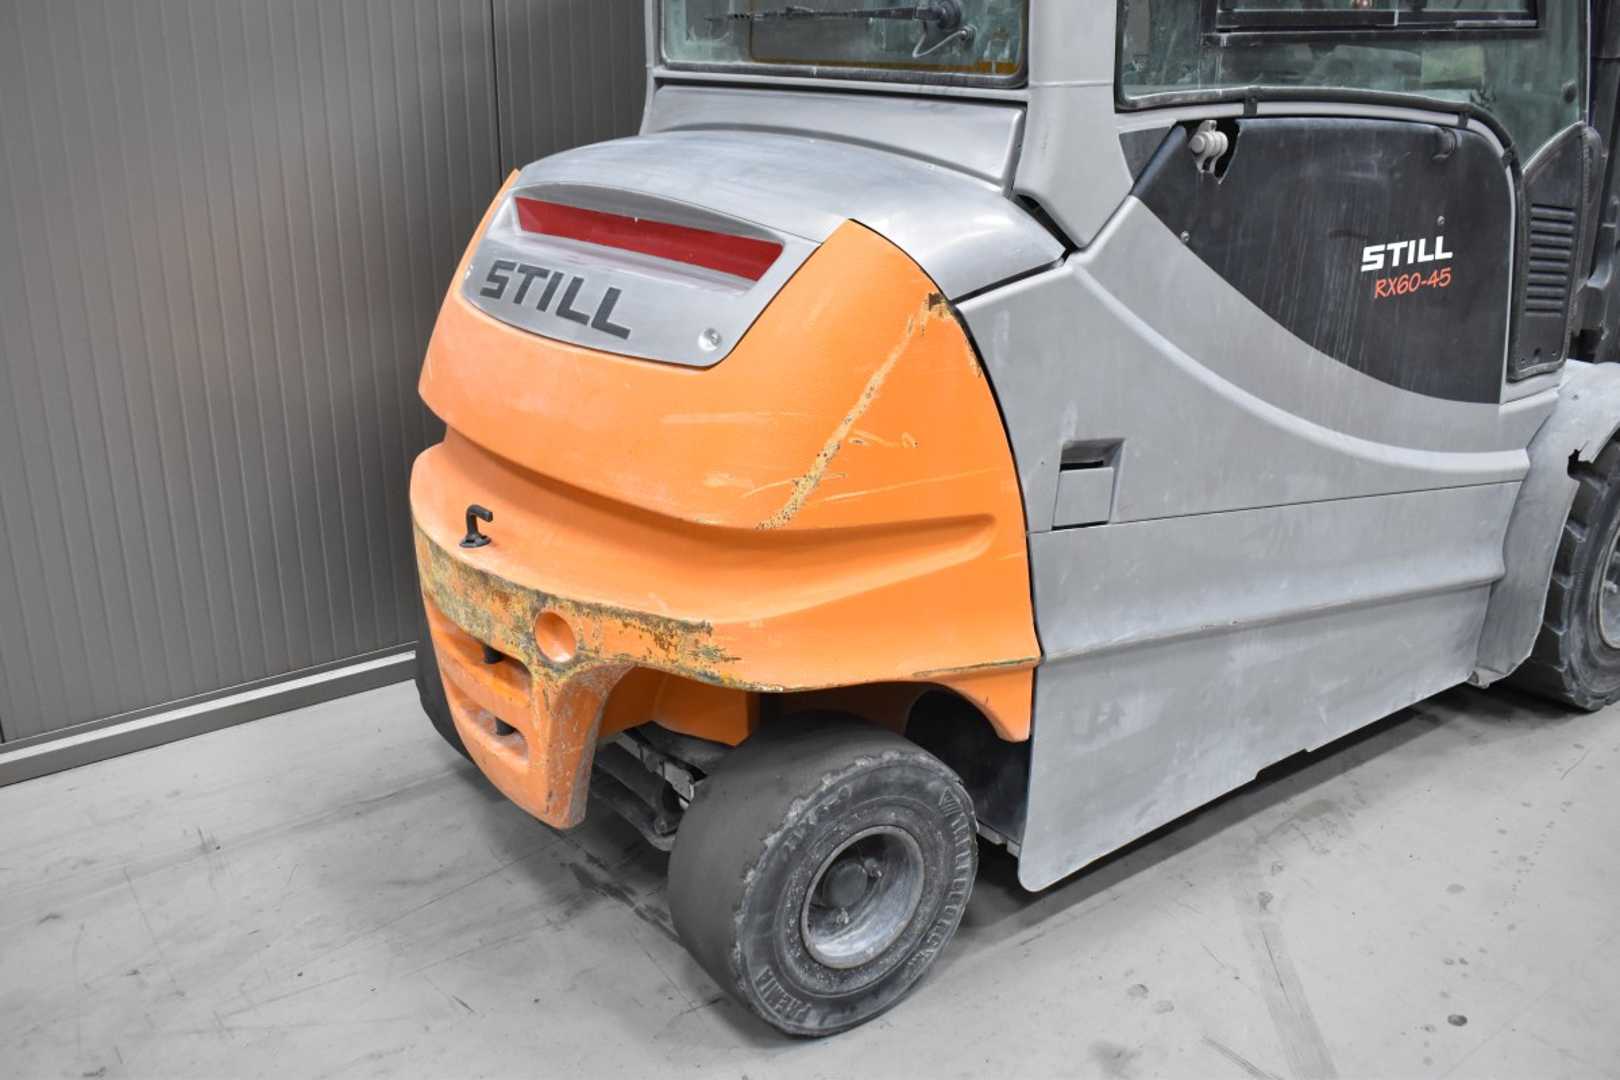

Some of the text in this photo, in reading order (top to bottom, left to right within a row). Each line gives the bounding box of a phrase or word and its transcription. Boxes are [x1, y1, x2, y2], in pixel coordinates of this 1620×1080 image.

[1361, 235, 1453, 272] STILL
[480, 259, 631, 340] STILL
[1374, 267, 1452, 299] RX60-45
